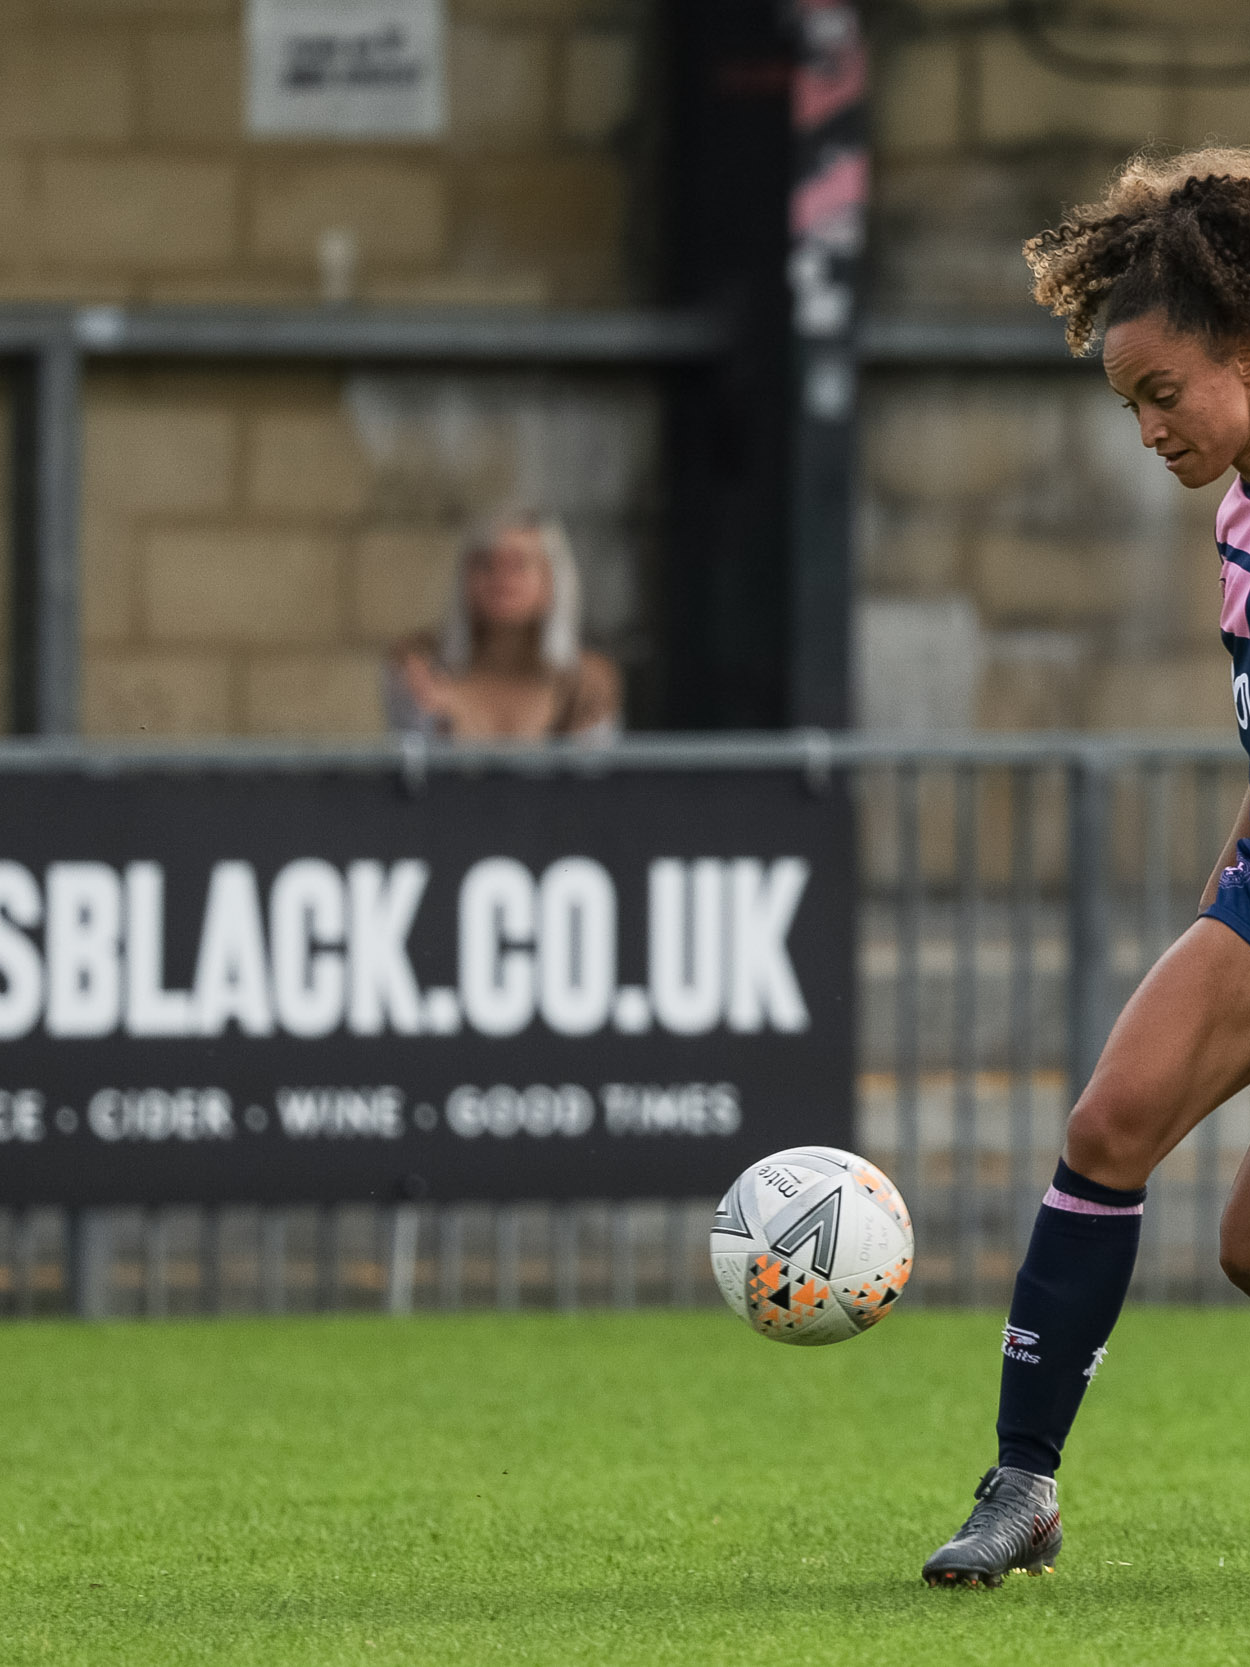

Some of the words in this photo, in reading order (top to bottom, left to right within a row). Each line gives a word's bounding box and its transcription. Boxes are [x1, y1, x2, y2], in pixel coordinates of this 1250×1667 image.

[87, 1087, 234, 1141] CIDER
[277, 1085, 404, 1139] WINE
[446, 1082, 595, 1138] GOOD
[600, 1081, 742, 1136] TIMES
[758, 1165, 799, 1199] mitre
